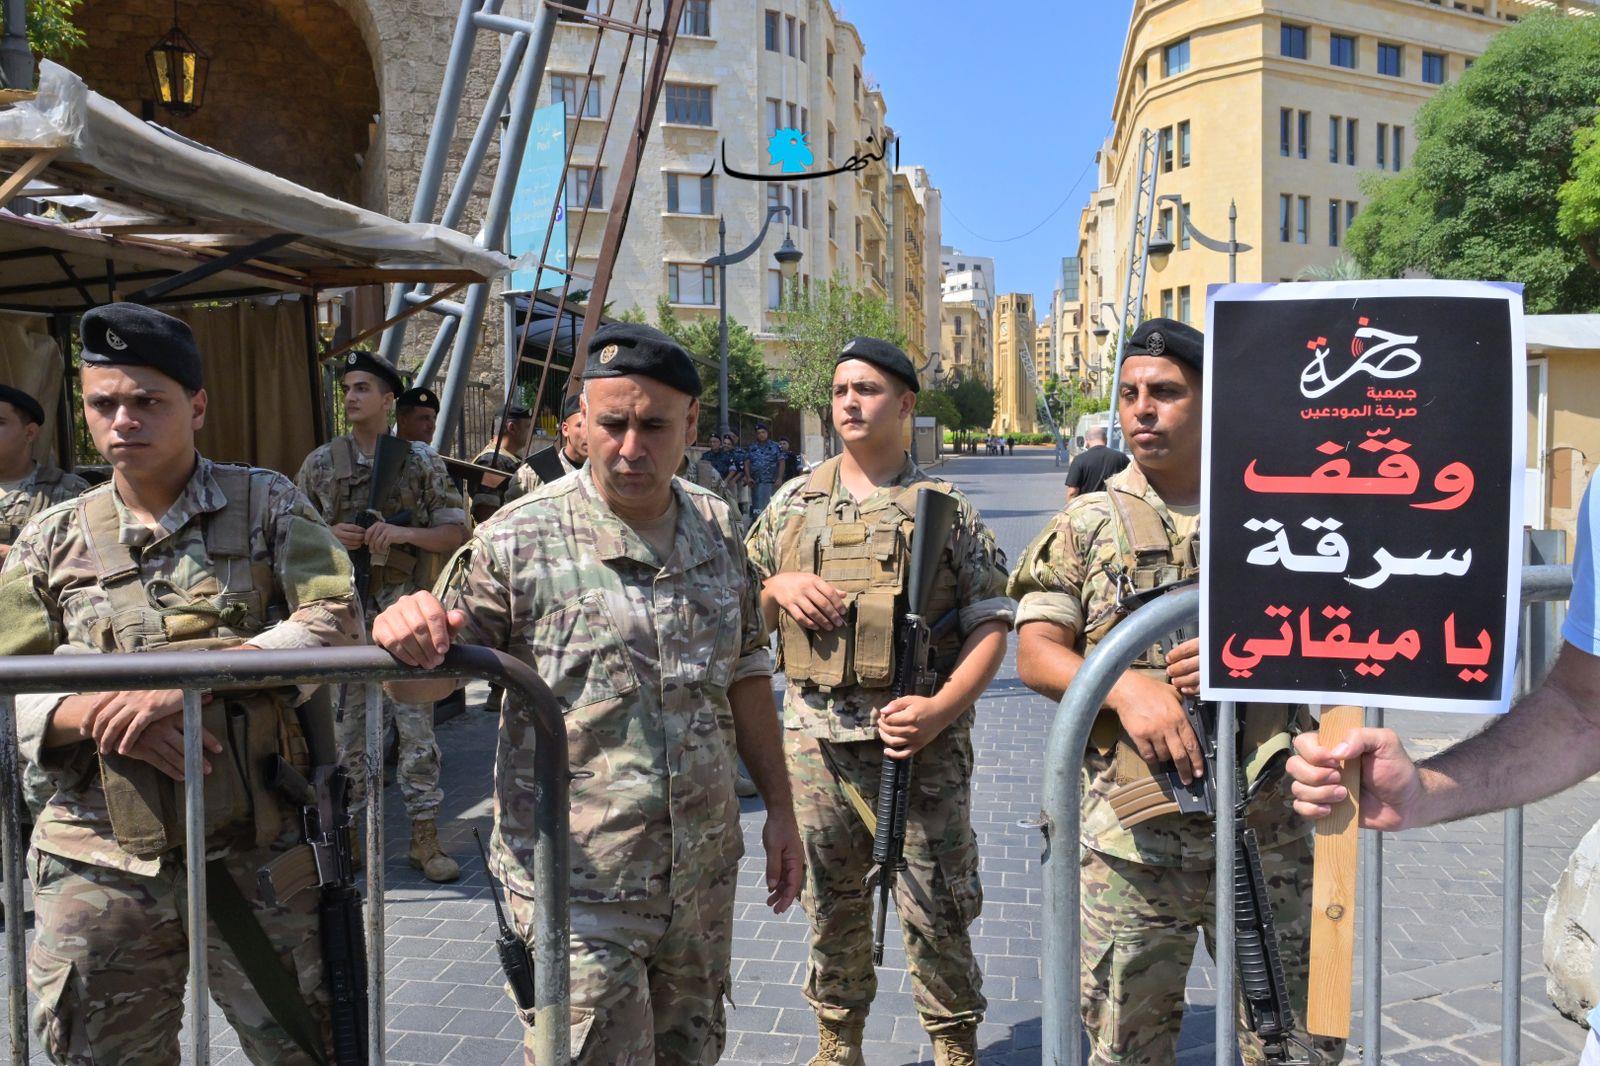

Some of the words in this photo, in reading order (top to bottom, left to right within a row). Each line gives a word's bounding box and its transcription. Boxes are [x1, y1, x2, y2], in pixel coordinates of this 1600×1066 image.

[1301, 404, 1371, 420] المودعين
[1366, 387, 1418, 400] جمعية
[1374, 404, 1418, 419] صرخة
[1242, 516, 1473, 589] سرقة
[1221, 604, 1421, 679] ميقاتي
[1443, 612, 1492, 683] يا
